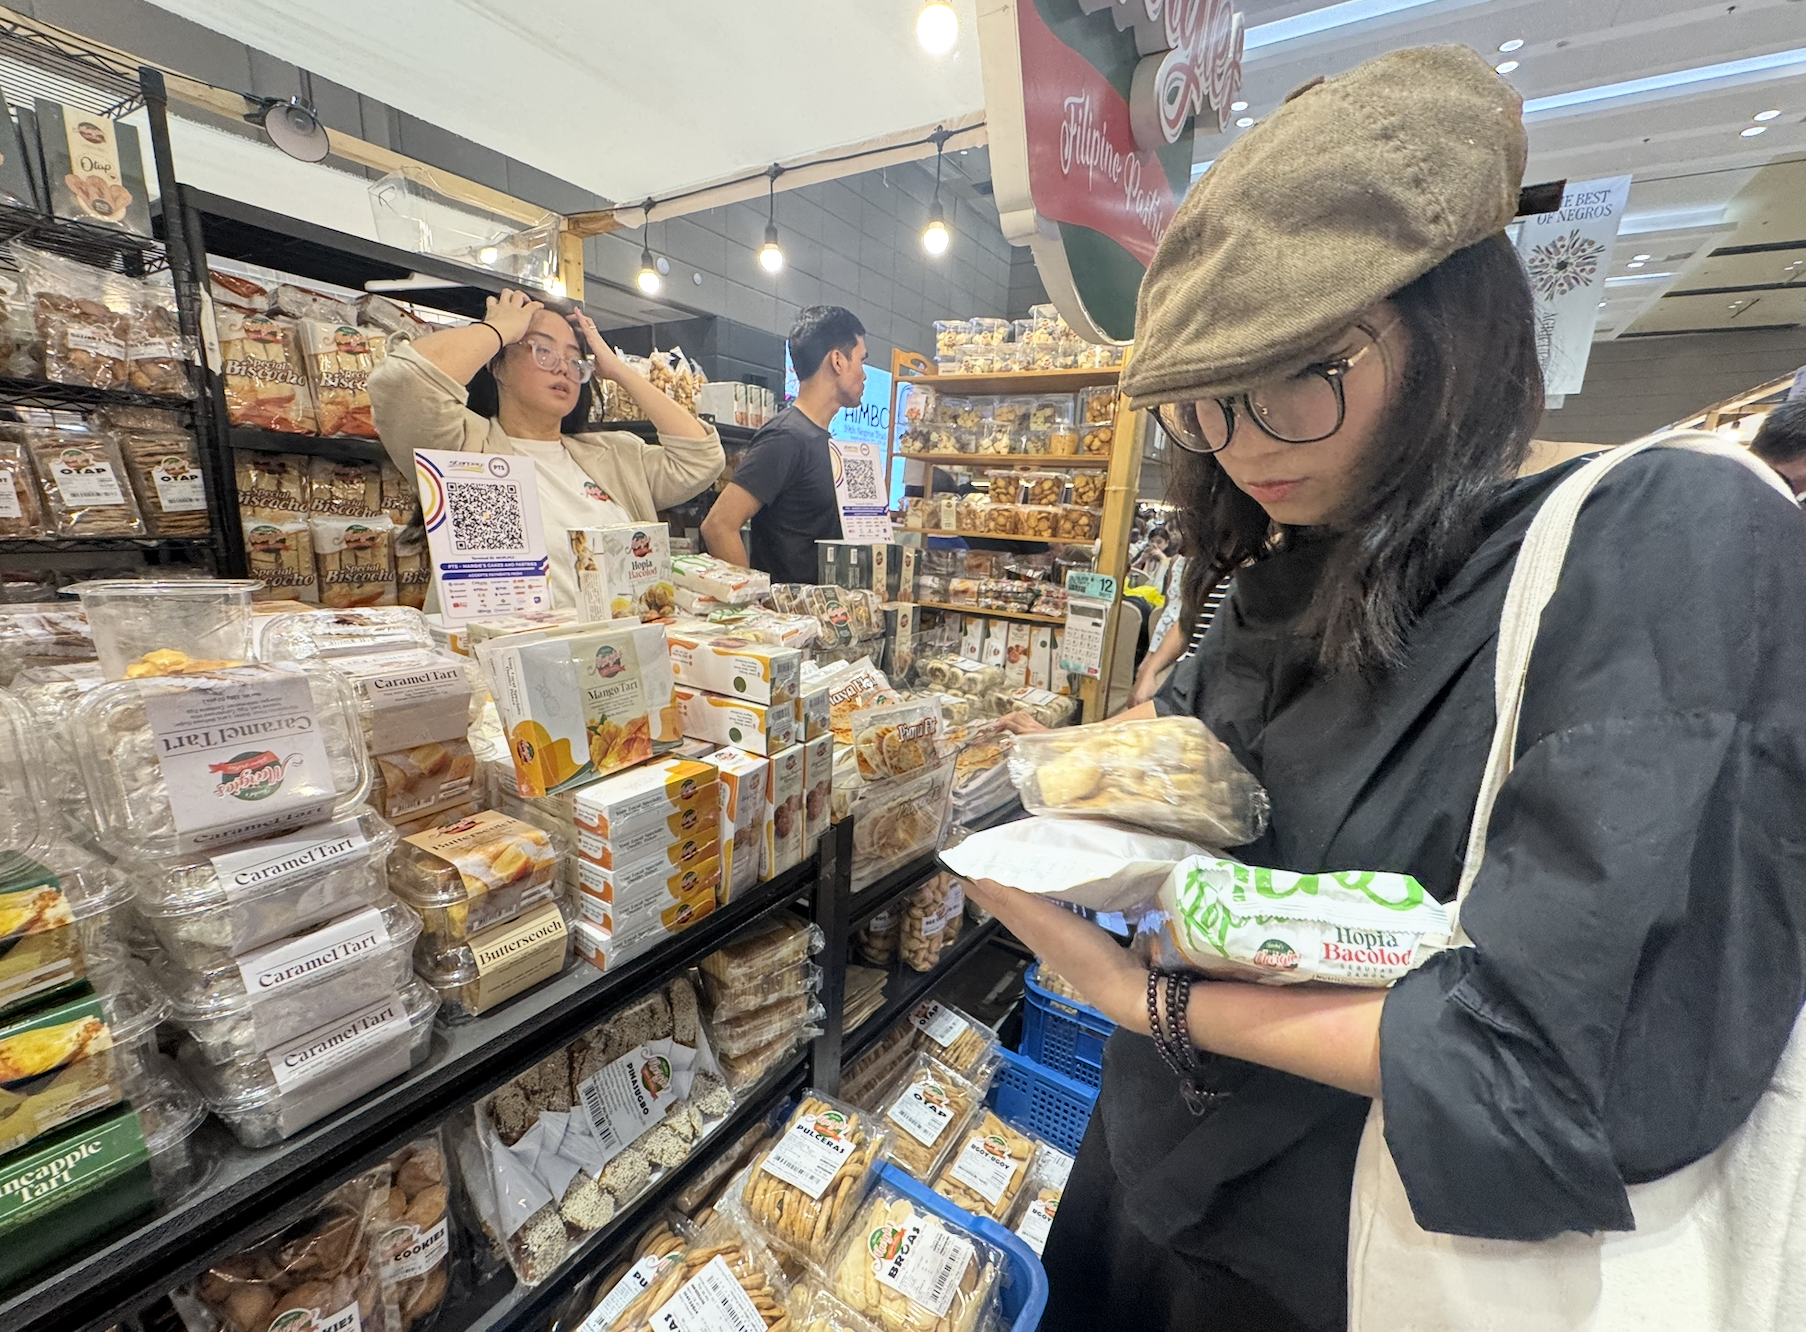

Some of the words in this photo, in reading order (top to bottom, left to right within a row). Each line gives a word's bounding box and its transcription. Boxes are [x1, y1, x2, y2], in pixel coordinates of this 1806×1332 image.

[81, 156, 111, 173] Otap
[1575, 189, 1611, 206] BEST
[1556, 203, 1613, 223] NEGROS
[225, 359, 306, 386] Biscocho
[247, 355, 287, 371] Special
[320, 372, 367, 392] Bisco
[160, 474, 199, 482] OTAP
[252, 487, 291, 499] Special
[252, 567, 293, 577] Special
[326, 570, 396, 584] Biscocho
[344, 563, 381, 573] Special
[263, 573, 315, 588] cocho
[1100, 578, 1113, 593] 12
[374, 673, 431, 689] Caramel
[429, 670, 458, 681] Tart
[587, 687, 619, 701] Mango
[618, 680, 638, 693] Tart
[219, 716, 312, 743] Caramel
[163, 731, 217, 751] Tart
[430, 819, 517, 850] Butterscotch
[234, 850, 316, 886] Caramel
[314, 838, 354, 858] Tart
[479, 919, 562, 966] Butterscotch
[1335, 926, 1398, 950] Hopia
[258, 948, 339, 987] Caramel
[338, 935, 377, 956] Tart
[1323, 942, 1412, 966] Bacolod
[919, 1004, 939, 1025] OTAP
[284, 1024, 359, 1067] Caramel
[358, 1007, 394, 1030] Tart
[627, 1062, 649, 1115] PINASUGBO
[913, 1092, 948, 1118] OTAP
[796, 1124, 845, 1154] PULCERAS
[970, 1143, 1011, 1170] UGOY-UGOY
[13, 1168, 72, 1203] Tart
[394, 1228, 446, 1261] COOKIES
[888, 1226, 920, 1279] BROAS
